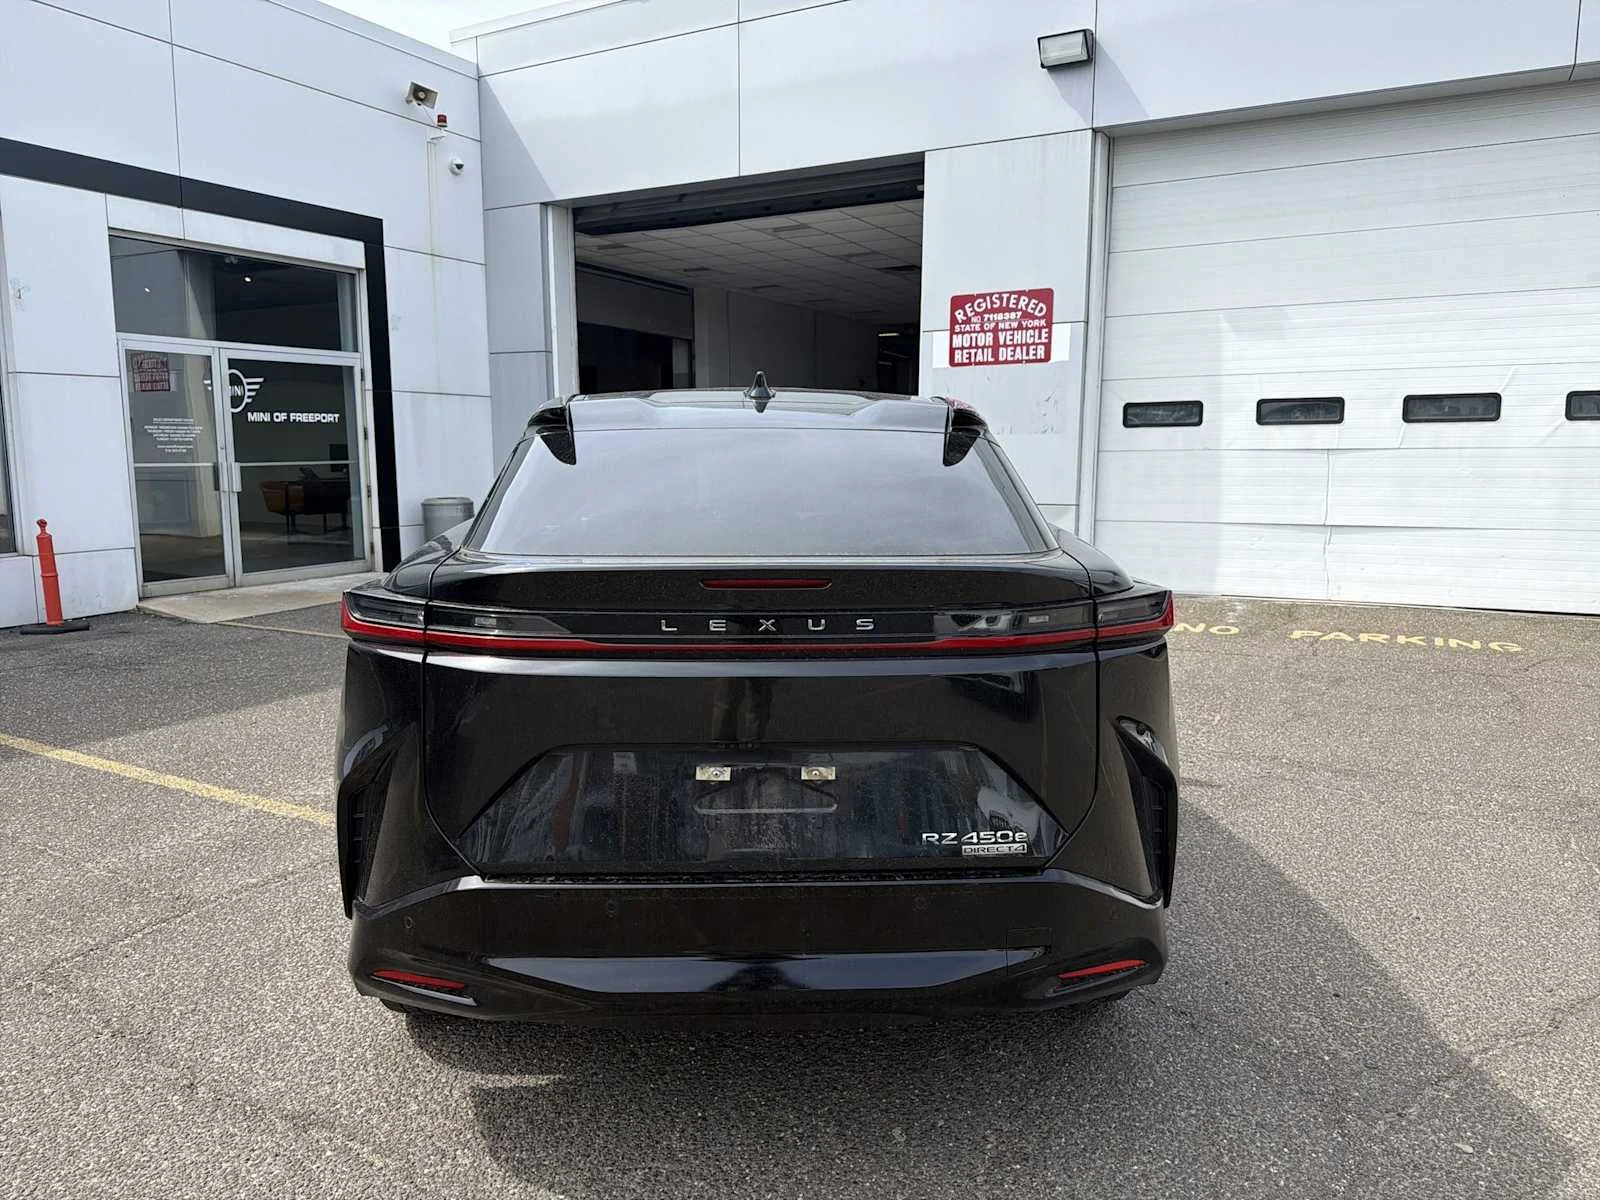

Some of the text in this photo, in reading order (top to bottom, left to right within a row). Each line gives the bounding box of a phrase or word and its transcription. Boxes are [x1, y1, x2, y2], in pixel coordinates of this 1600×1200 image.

[954, 293, 1047, 323] REGISTERED
[954, 319, 1046, 332] STATE OF NEW YORK
[952, 328, 1049, 348] MOTOR VEHICLE
[954, 345, 1045, 363] RETAIL DEALER
[247, 411, 340, 423] MINI OF FREEPORT
[660, 618, 875, 632] LEXUS
[1173, 622, 1524, 652] NO PARKING
[921, 830, 1029, 845] RZ 450e
[962, 843, 1027, 855] DIRECT4
